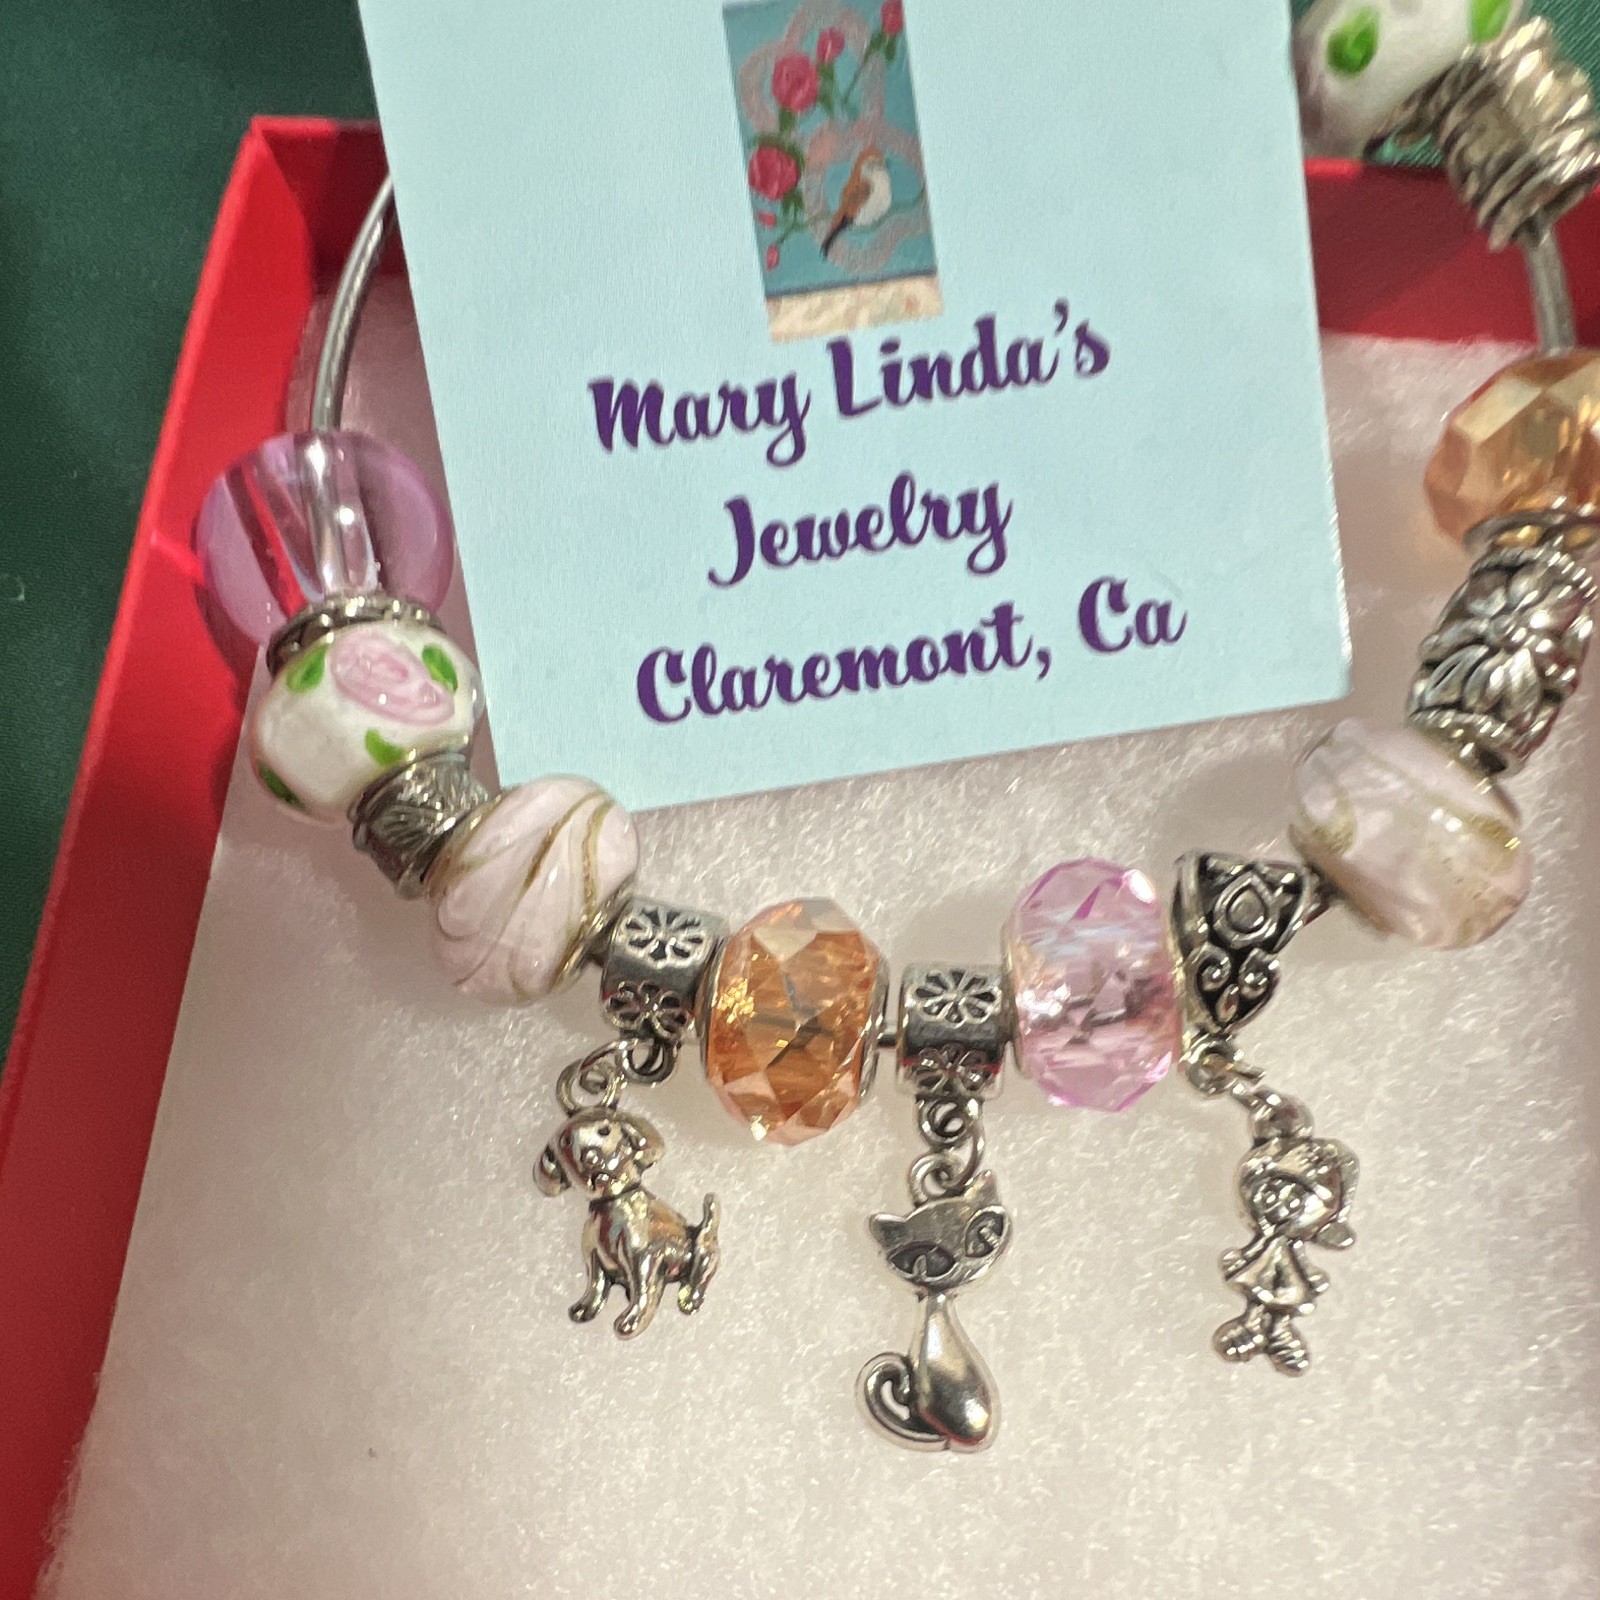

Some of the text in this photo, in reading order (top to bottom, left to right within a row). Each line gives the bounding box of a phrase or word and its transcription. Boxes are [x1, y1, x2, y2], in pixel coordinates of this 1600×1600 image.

[588, 299, 1111, 467] Mary Linda's
[708, 471, 1013, 587] Jewelry
[636, 576, 1187, 723] Claremont, Ca
